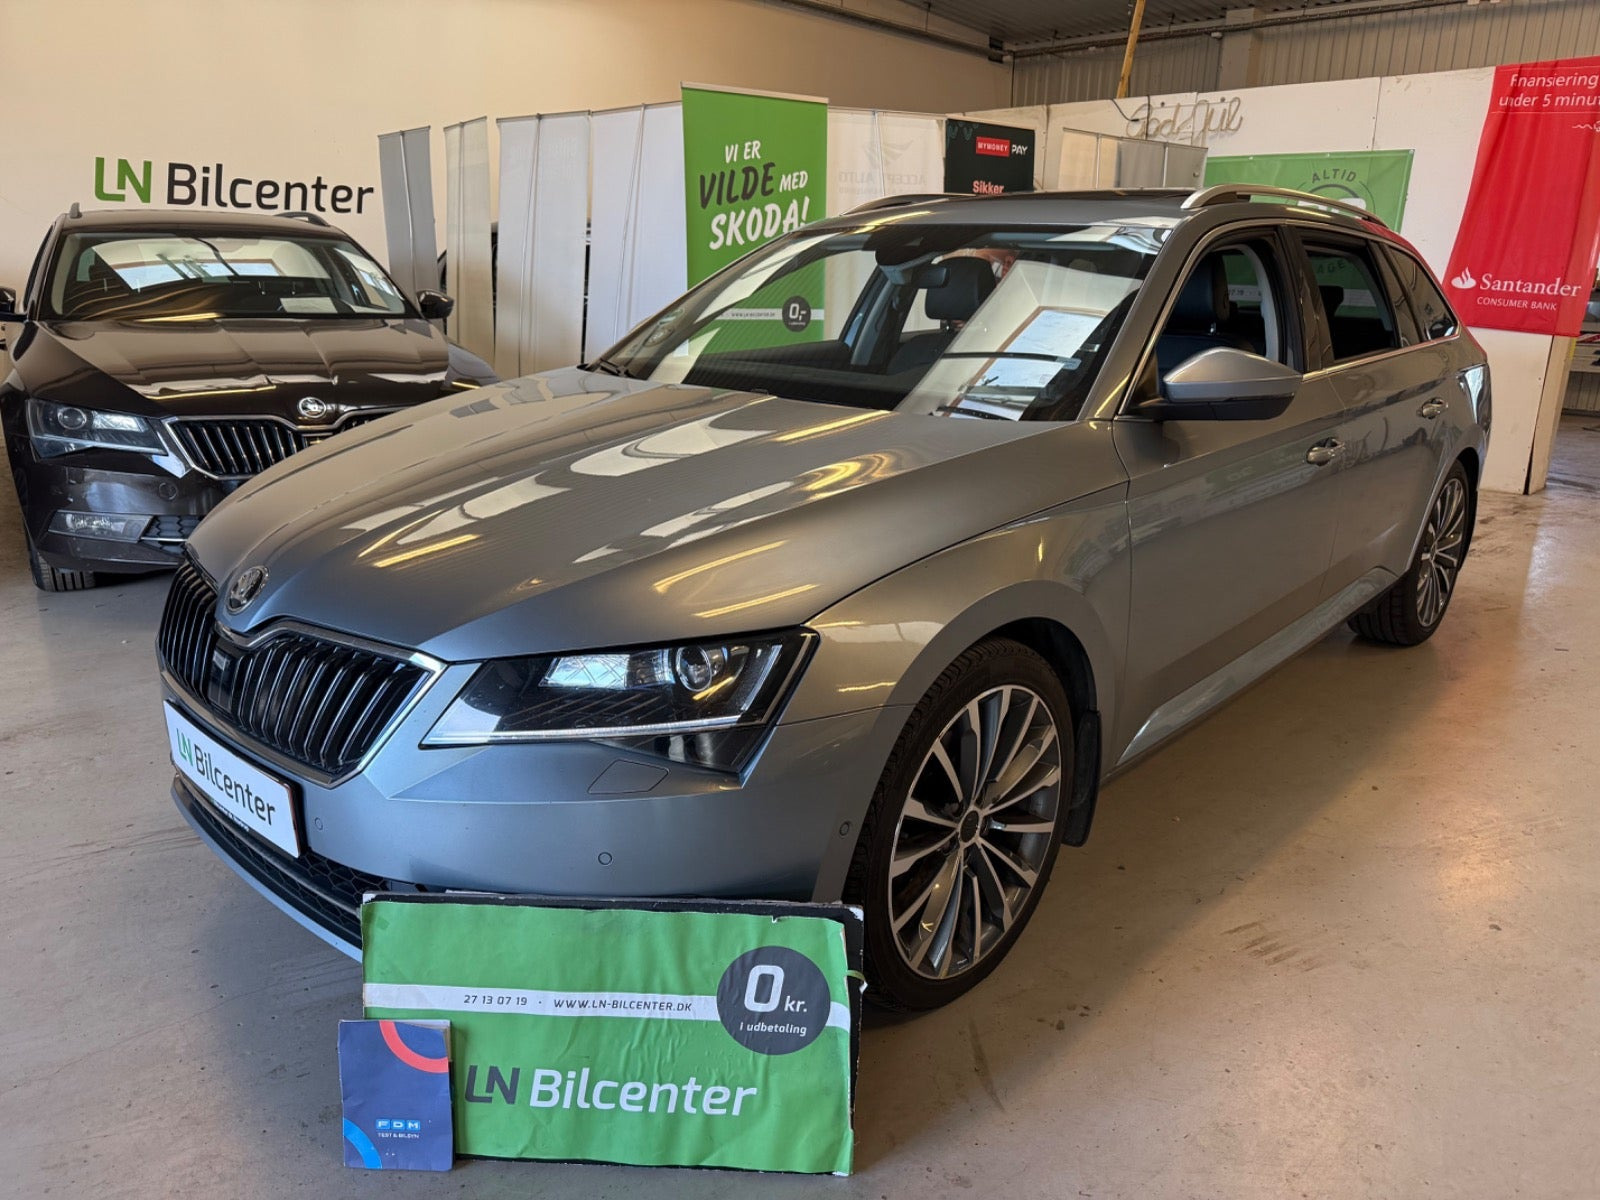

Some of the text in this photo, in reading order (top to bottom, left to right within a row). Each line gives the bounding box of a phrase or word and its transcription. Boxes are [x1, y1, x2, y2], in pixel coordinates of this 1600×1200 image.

[1510, 72, 1599, 89] Fnansiering
[1542, 93, 1552, 107] 5
[725, 140, 761, 163] VI ER
[1011, 144, 1028, 155] PAY
[1311, 168, 1357, 184] ALTID
[94, 157, 374, 214] LN Bilcenter
[699, 162, 808, 209] VILDE MED
[972, 180, 1005, 194] Sikker
[709, 196, 810, 250] SKODA!
[1480, 273, 1582, 297] Santander
[1477, 296, 1557, 311] CONSUMER BANK
[176, 728, 194, 767] LN
[193, 743, 277, 826] Bilcenter
[743, 964, 808, 1013] 0 kr.
[463, 994, 692, 1012] 27 13 07 19 WWW.LN-BILCENTER.DK
[746, 1022, 808, 1037] udbetaling
[464, 1065, 758, 1117] LN Bilcenter
[377, 1120, 419, 1129] FDM
